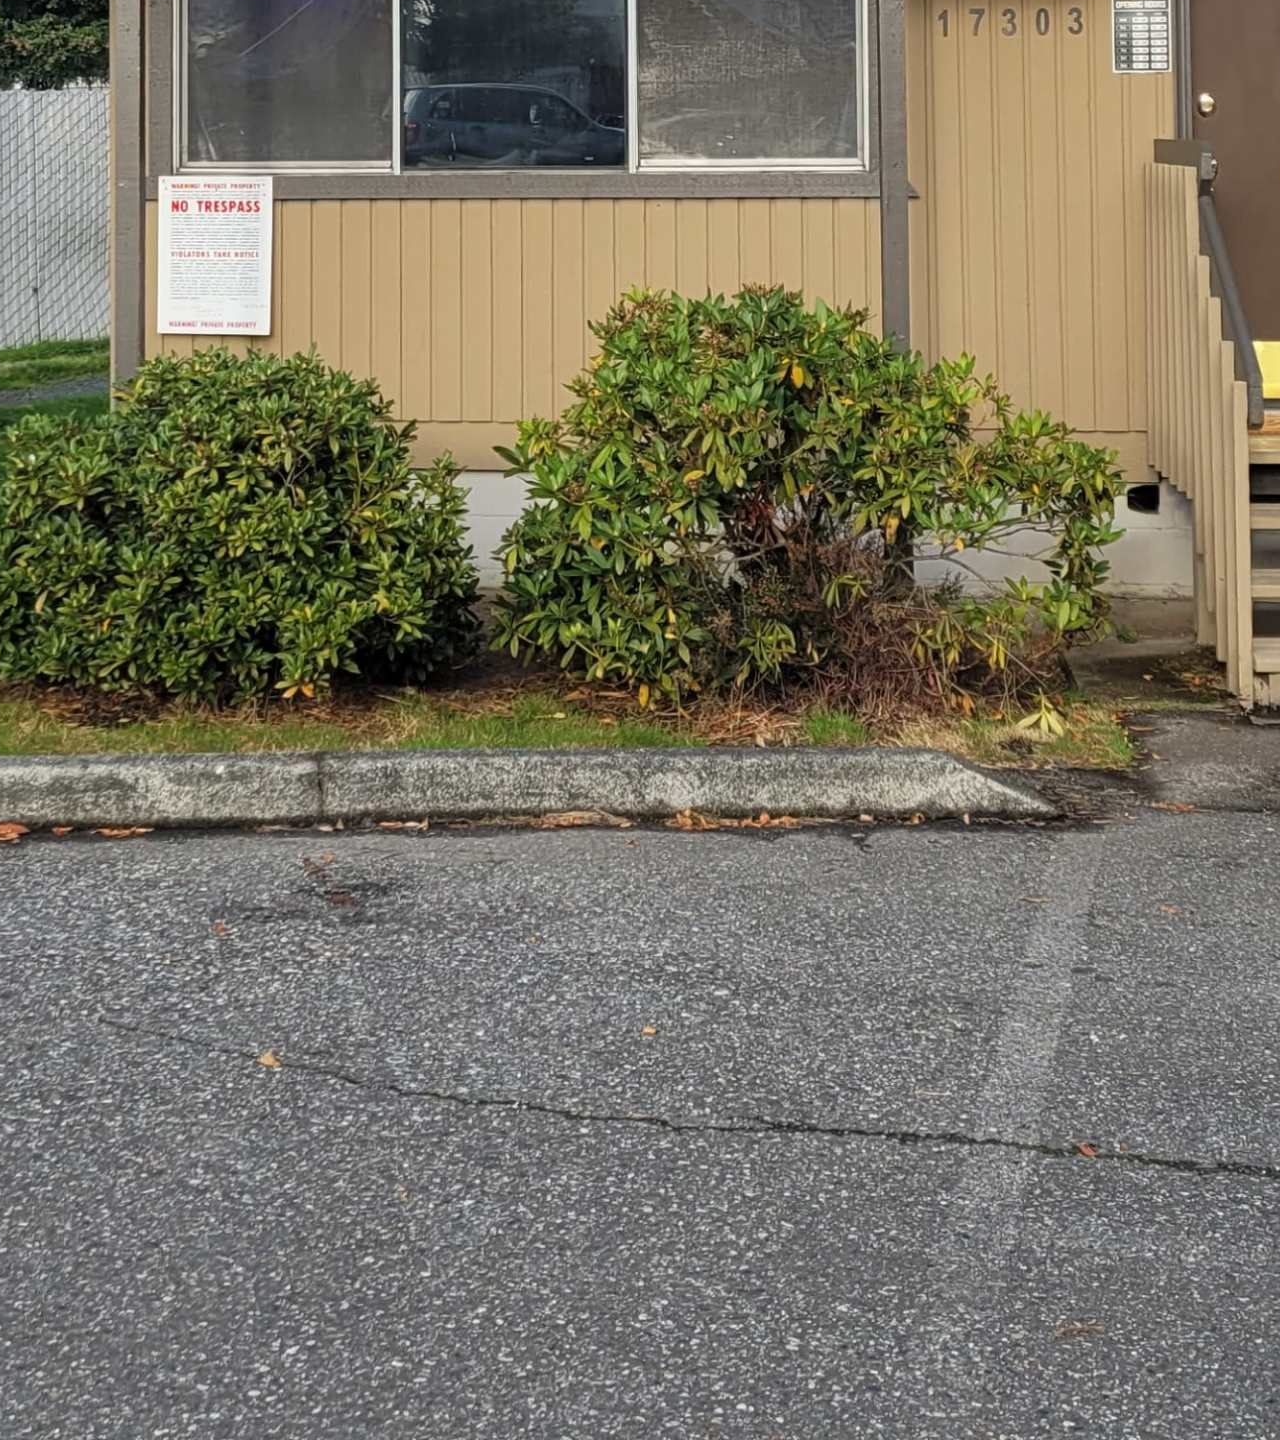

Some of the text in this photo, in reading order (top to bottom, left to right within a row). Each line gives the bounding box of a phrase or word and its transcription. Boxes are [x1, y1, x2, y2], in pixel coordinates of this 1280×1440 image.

[937, 7, 1084, 37] 17303
[171, 200, 261, 212] NO TRESPASS
